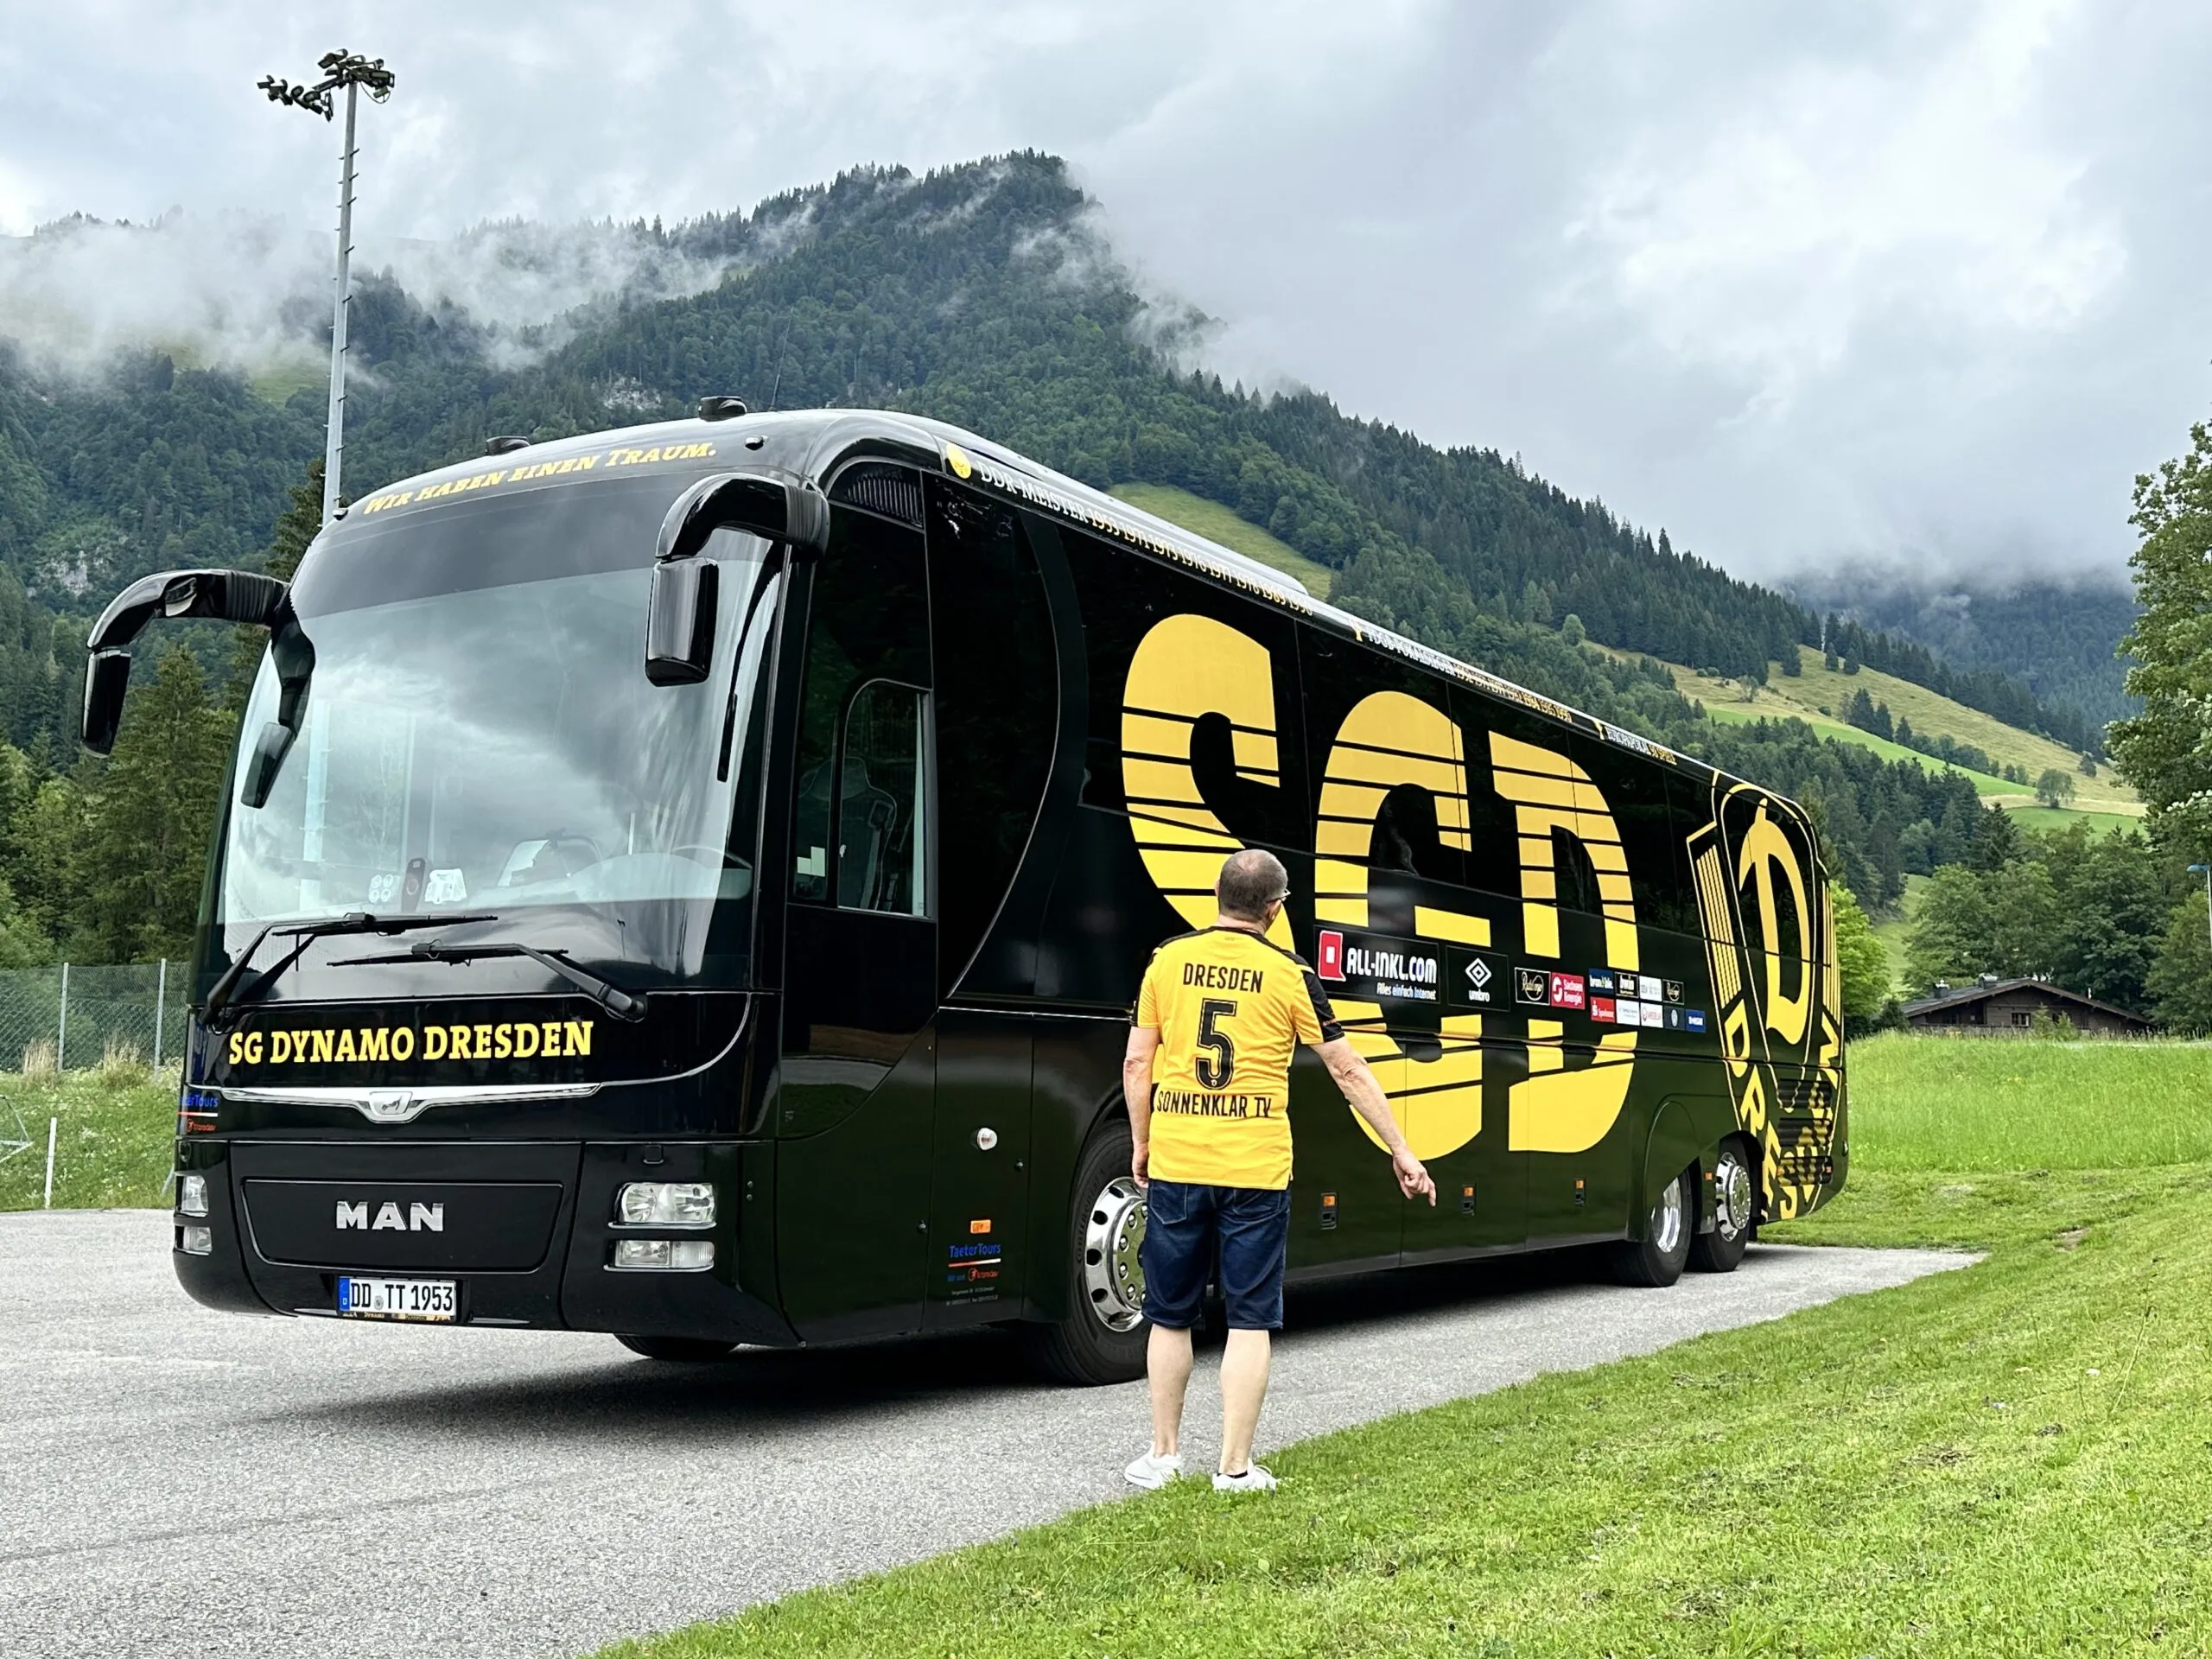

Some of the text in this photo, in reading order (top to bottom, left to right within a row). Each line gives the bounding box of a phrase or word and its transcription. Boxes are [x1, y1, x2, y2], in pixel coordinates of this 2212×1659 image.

[415, 471, 506, 502] HABEN
[507, 454, 601, 482] EINEN
[976, 461, 1089, 524] DDR-MEISTER
[1183, 963, 1263, 994] DRESDEN
[1346, 947, 1437, 984] ALL-INKL.COM
[1376, 982, 1391, 995] Alles
[1469, 988, 1490, 1002] umbro
[229, 1020, 594, 1064] SG DYNAMO DRESDEN
[1195, 998, 1237, 1090] 5
[1157, 1090, 1272, 1118] SONNENKLAR TV
[336, 1201, 444, 1231] MAN
[351, 1283, 453, 1311] DD TT 1953
